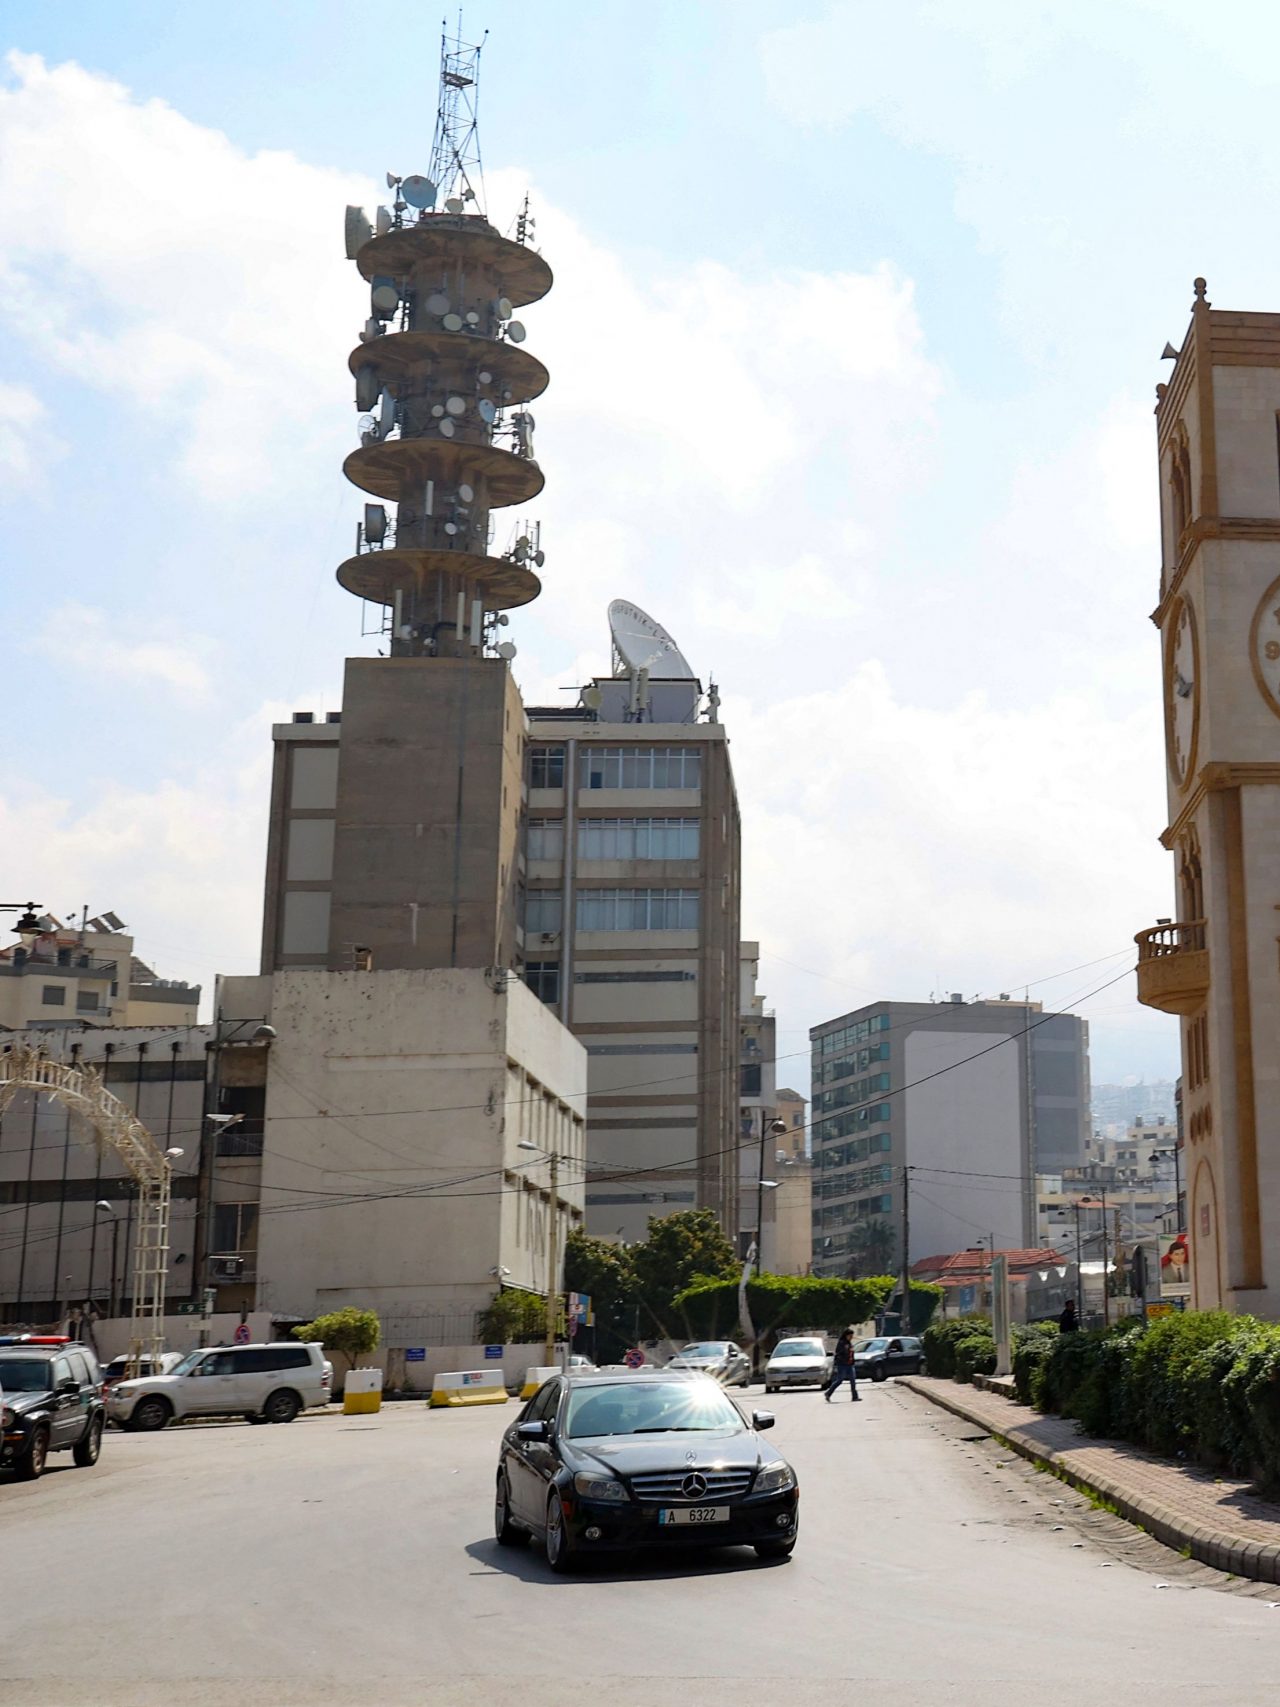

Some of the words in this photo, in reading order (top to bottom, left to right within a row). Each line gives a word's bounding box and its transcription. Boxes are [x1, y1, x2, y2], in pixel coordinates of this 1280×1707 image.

[1265, 641, 1280, 660] 9
[668, 1510, 676, 1523] A
[689, 1508, 717, 1522] 6322
